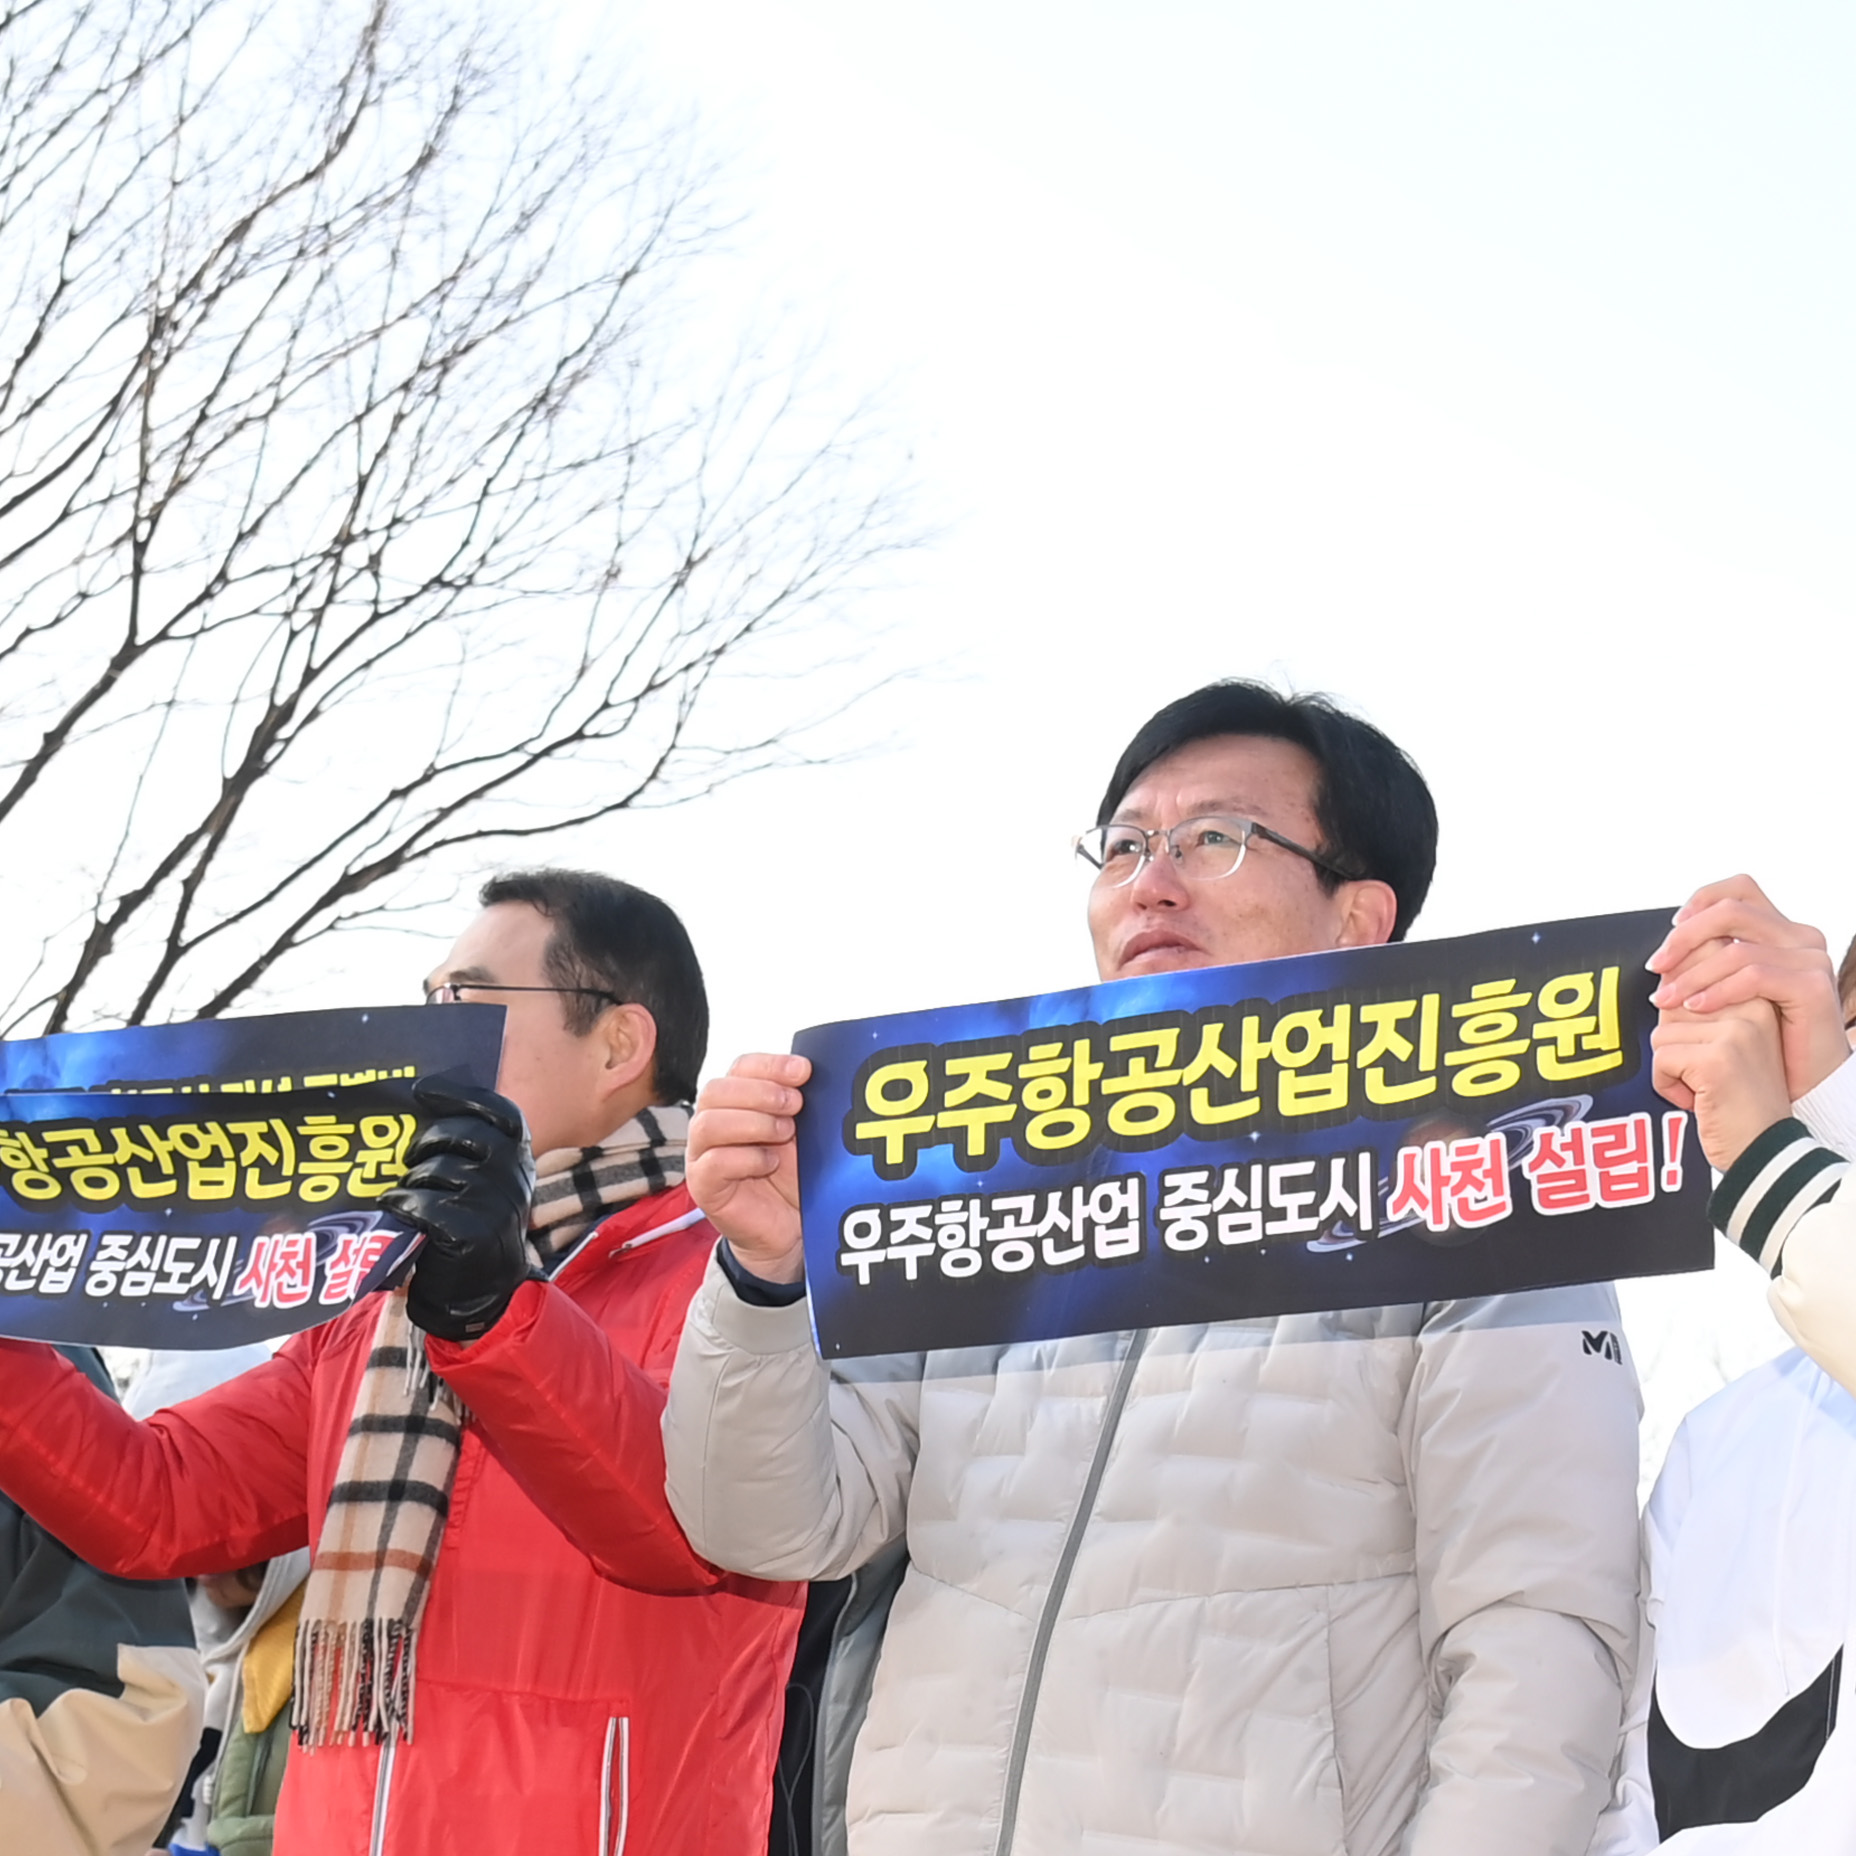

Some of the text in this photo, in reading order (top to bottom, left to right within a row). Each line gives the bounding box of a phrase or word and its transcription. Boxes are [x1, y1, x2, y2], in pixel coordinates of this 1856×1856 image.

[856, 967, 1624, 1166] 우주항공산업진흥원
[84, 1234, 237, 1300] 중심도시
[237, 1234, 315, 1306] 사천
[840, 1115, 1685, 1286] 우주항공산업 중심도시 사천 설립!
